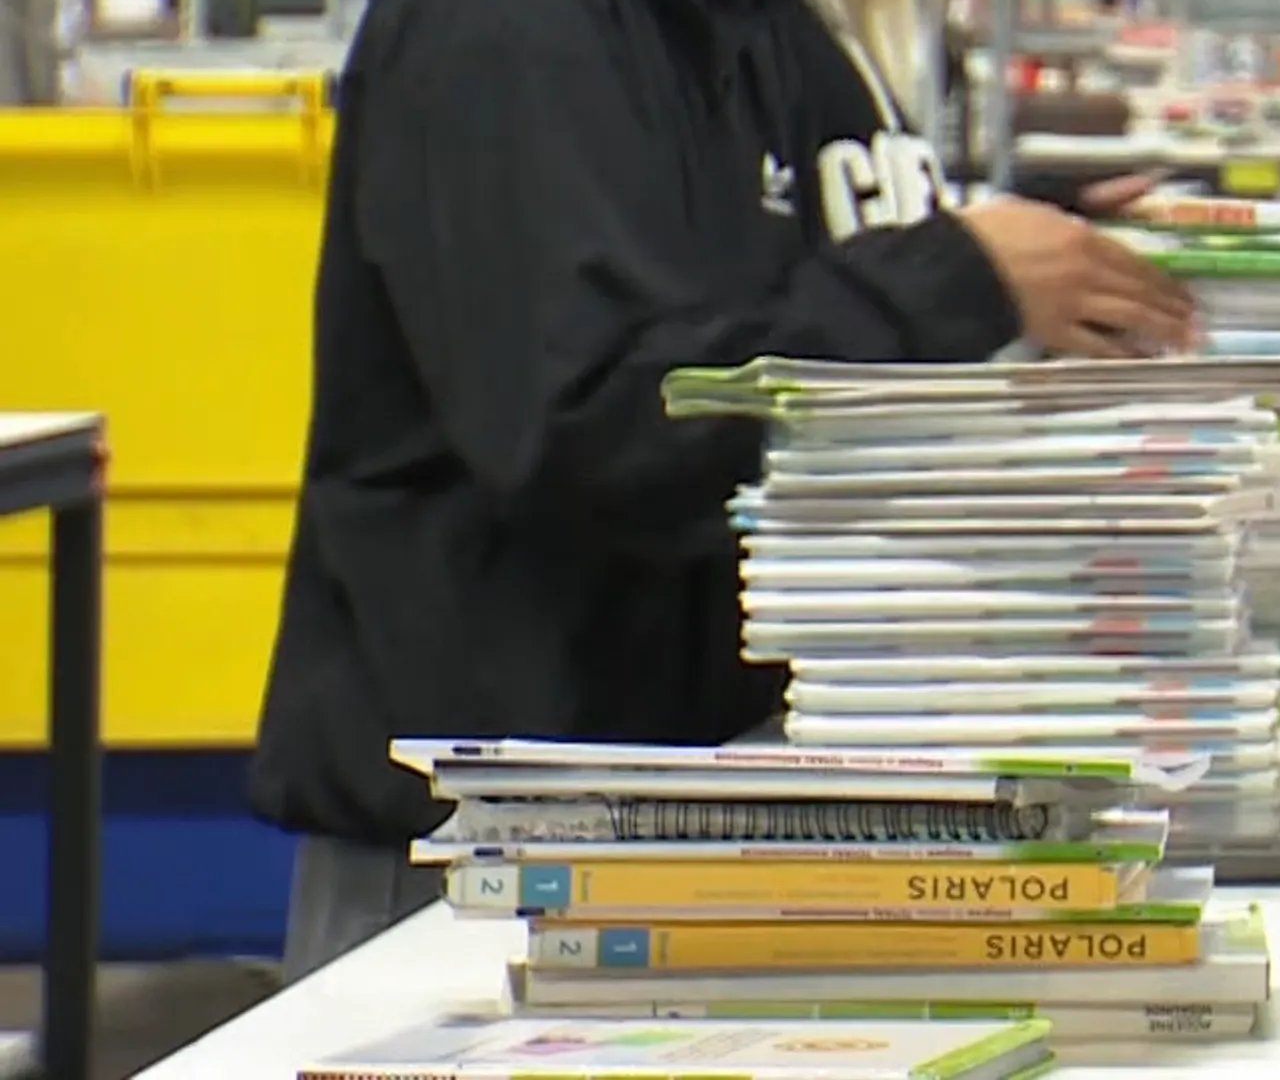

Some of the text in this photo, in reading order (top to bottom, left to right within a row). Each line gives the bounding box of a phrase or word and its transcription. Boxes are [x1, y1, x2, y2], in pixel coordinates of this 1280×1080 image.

[481, 878, 503, 894] 2
[535, 879, 559, 892] 1
[907, 876, 1067, 902] POLARIS
[560, 940, 581, 957] 2
[613, 941, 638, 953] 1
[985, 933, 1146, 960] POLARIS
